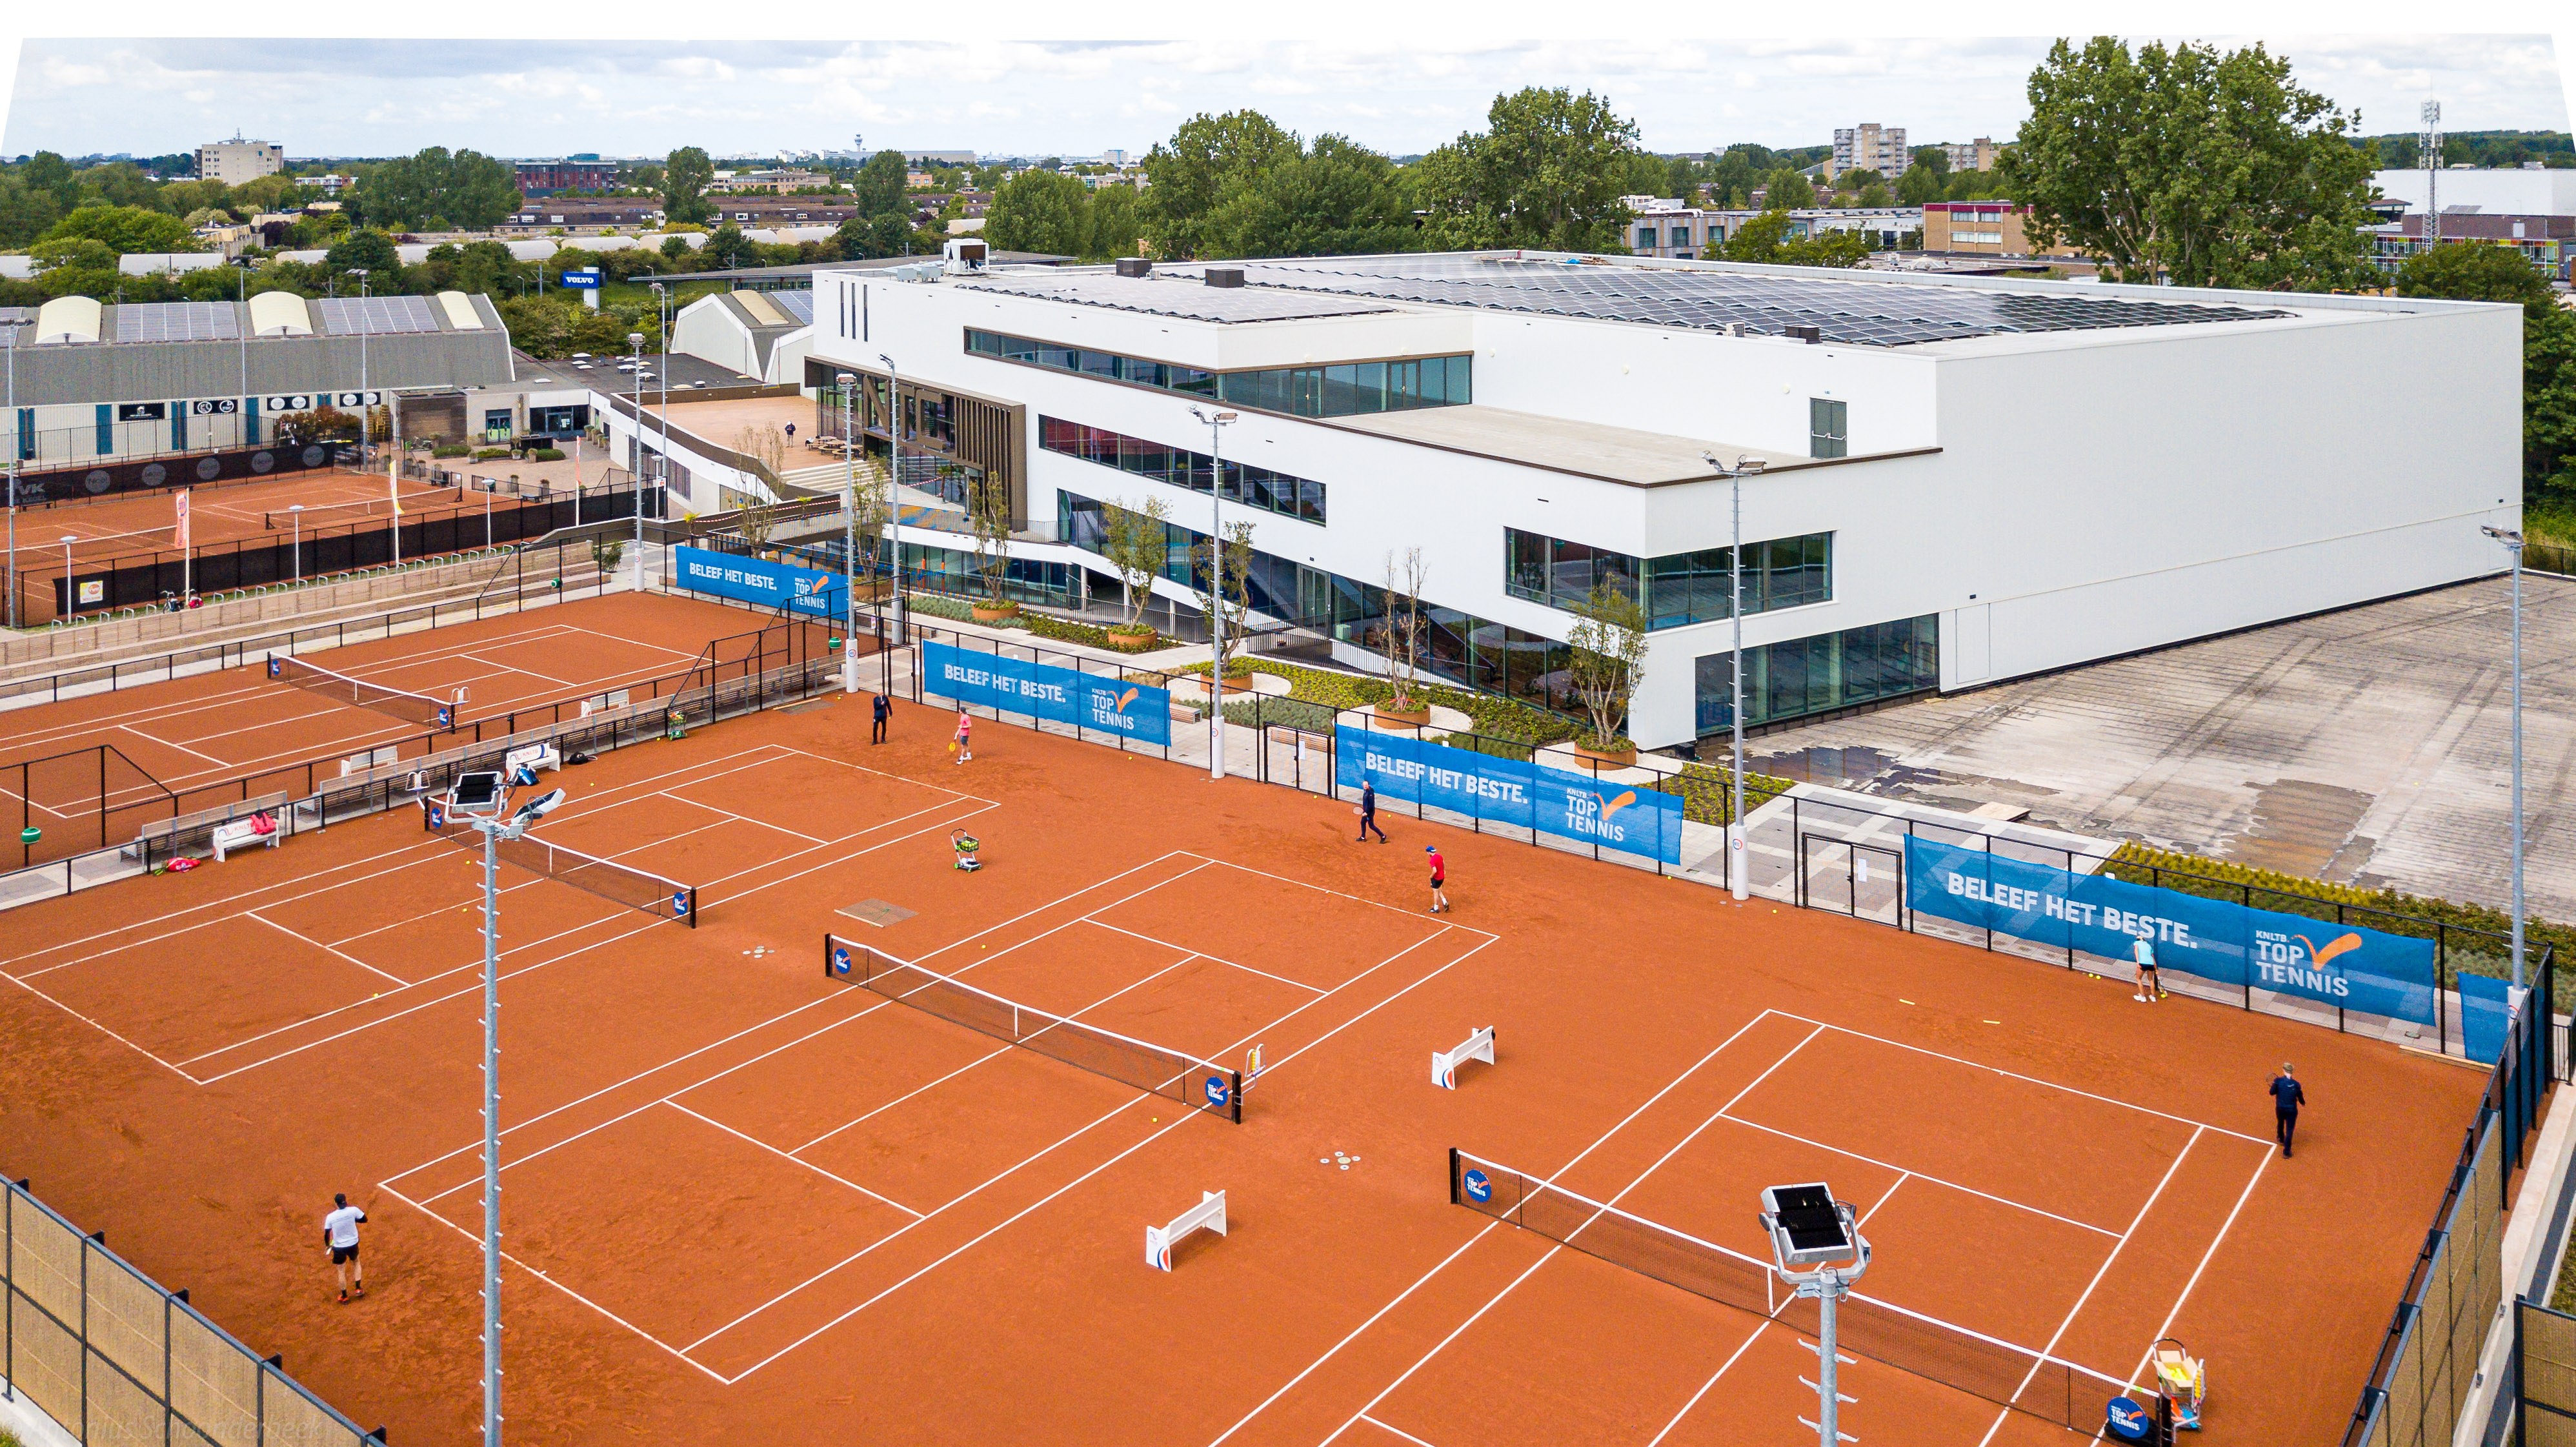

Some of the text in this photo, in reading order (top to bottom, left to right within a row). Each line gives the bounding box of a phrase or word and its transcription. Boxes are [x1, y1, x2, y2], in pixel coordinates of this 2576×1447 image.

[863, 375, 947, 450] NTC
[689, 562, 778, 591] BELEEF HET BESTE.
[794, 582, 810, 595] TOP
[794, 593, 825, 609] TENNIS
[945, 663, 1066, 702] BELEEF HET BESTE.
[1092, 694, 1114, 711] TOP
[1092, 708, 1134, 730] TENNIS
[1365, 752, 1528, 804] BELEEF HET BESTE.
[1566, 794, 1598, 817] TOP
[234, 822, 252, 832] KNLT
[1565, 812, 1624, 842] TENNIS
[1947, 872, 2198, 949] BELEEF HET BESTE.
[2255, 940, 2304, 965] TOP
[2256, 960, 2350, 997] TENNIS
[2111, 1408, 2127, 1419] TOP
[2111, 1414, 2140, 1431] TENNIS
